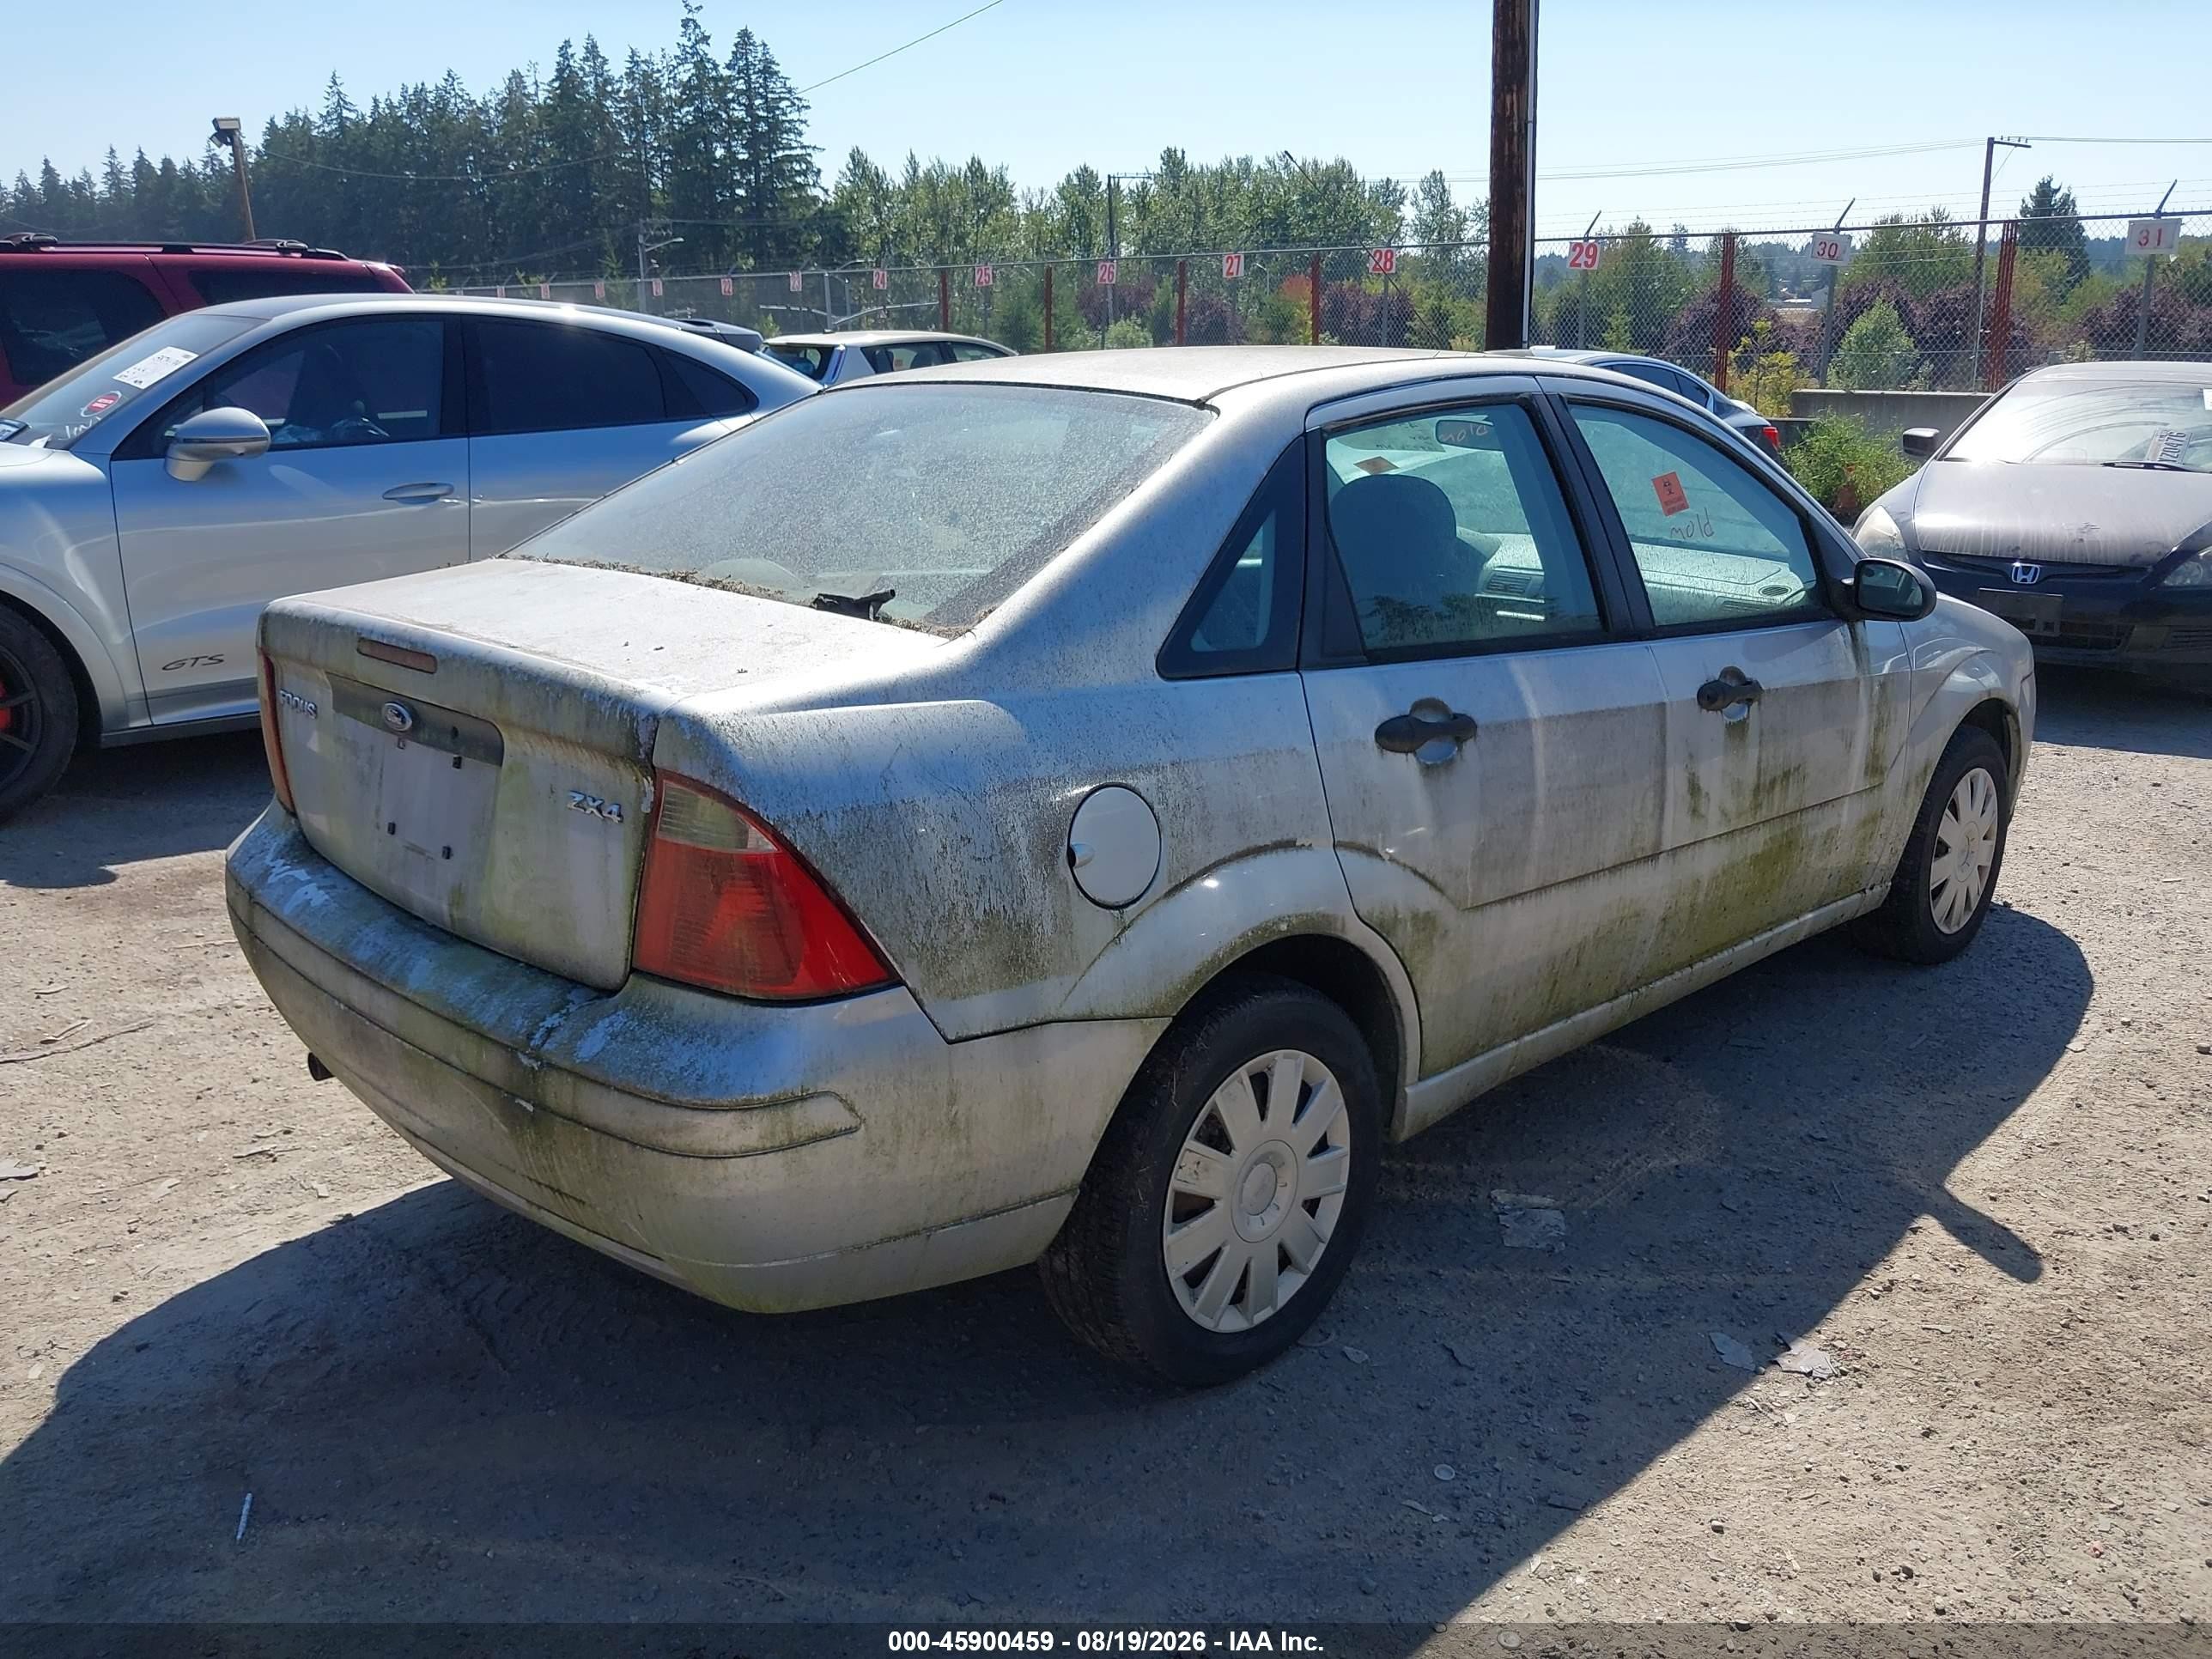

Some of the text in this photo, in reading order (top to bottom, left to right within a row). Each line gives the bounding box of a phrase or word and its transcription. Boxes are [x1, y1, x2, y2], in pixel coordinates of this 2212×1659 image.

[2137, 228, 2162, 246] 31
[1569, 242, 1598, 268] 29
[1817, 241, 1838, 258] 30
[1225, 255, 1242, 276] 27
[1371, 249, 1395, 271] 28
[874, 270, 887, 289] 24
[977, 267, 991, 285] 25
[1100, 264, 1115, 283] 26
[1670, 507, 1715, 539] mold
[161, 653, 225, 672] GTS
[568, 790, 624, 823] ZX4
